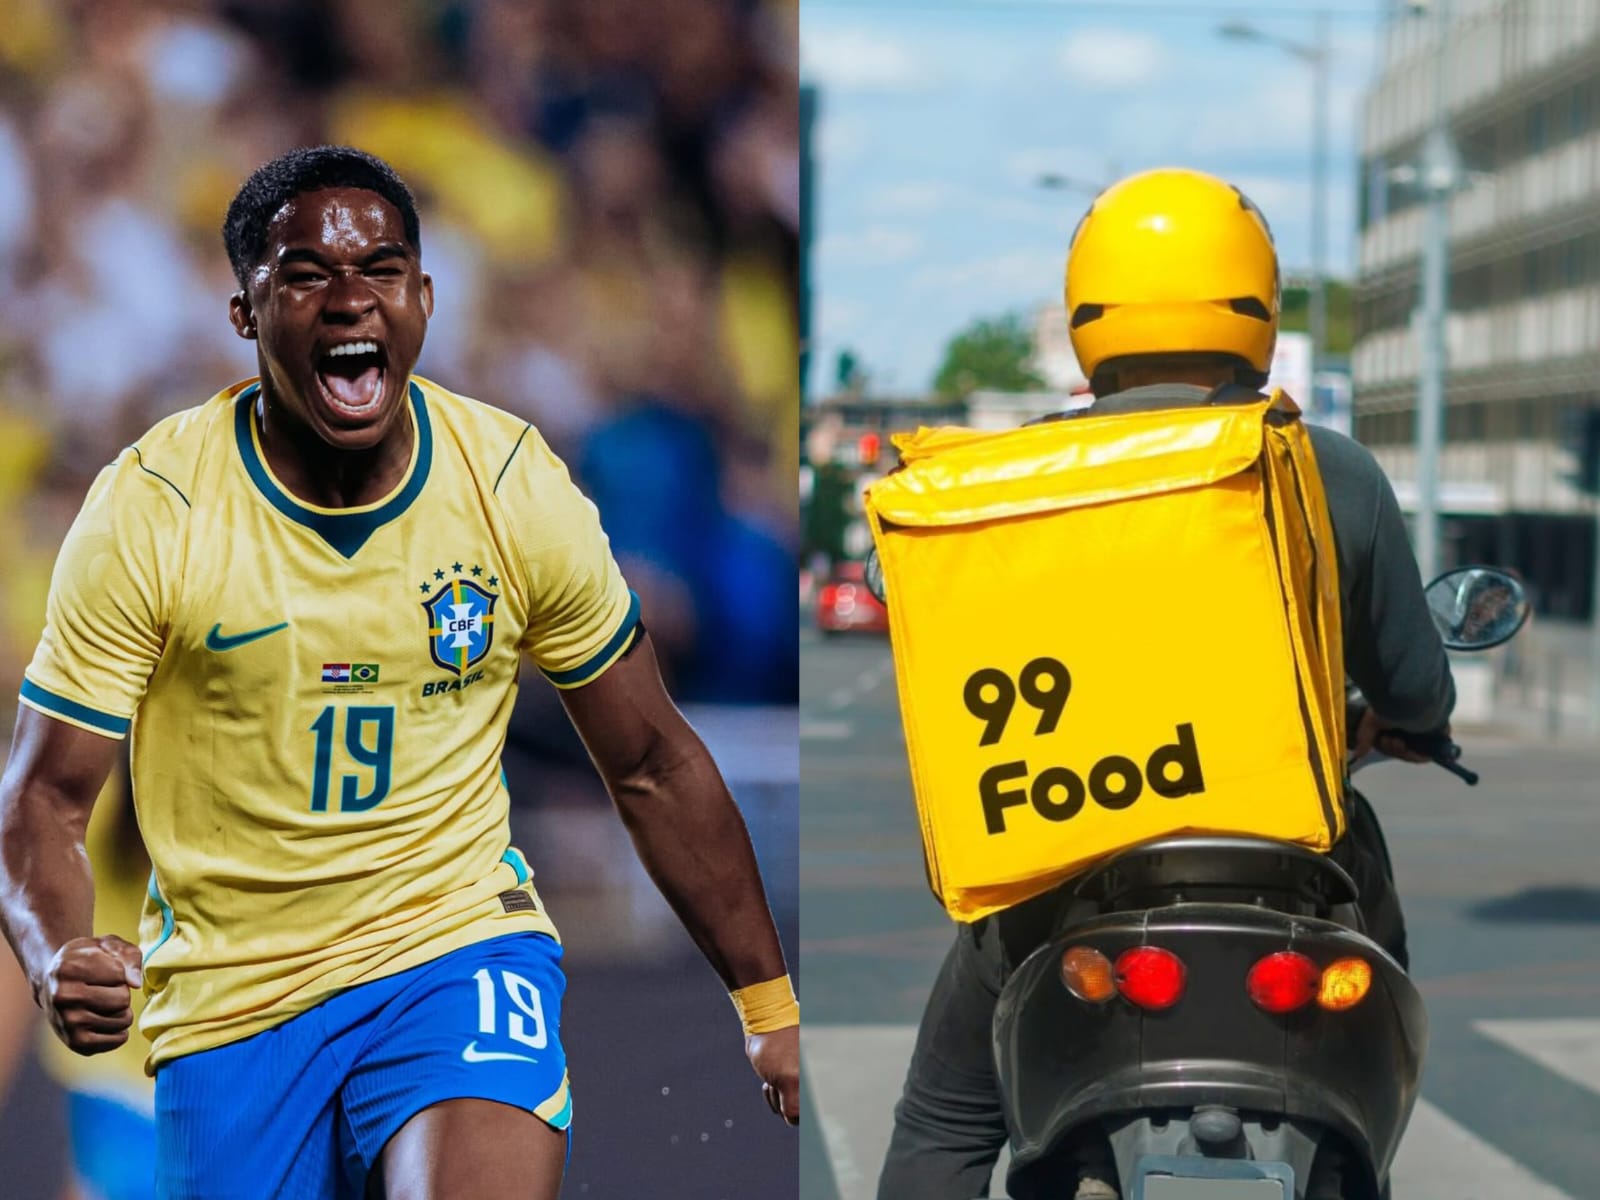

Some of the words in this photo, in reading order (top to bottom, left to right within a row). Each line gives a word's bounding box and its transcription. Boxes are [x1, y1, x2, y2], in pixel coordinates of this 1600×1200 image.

[449, 619, 475, 632] CBF
[422, 670, 485, 697] BRASIL
[963, 656, 1072, 747] 99
[309, 705, 396, 812] 19
[979, 722, 1205, 835] Food
[472, 968, 547, 1050] 19
